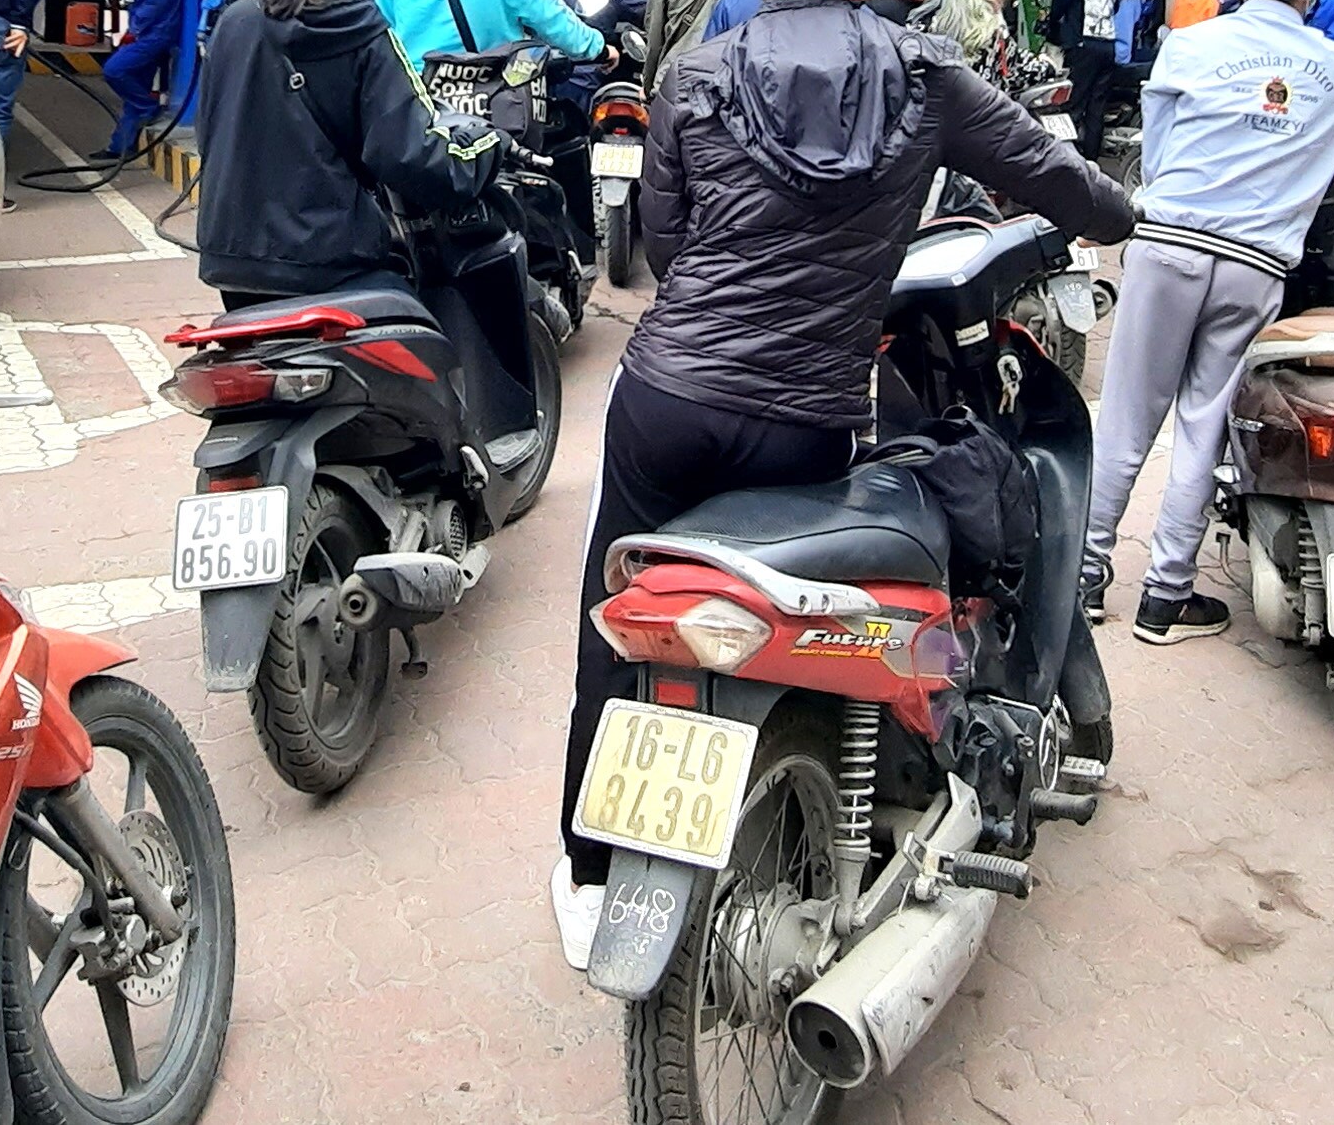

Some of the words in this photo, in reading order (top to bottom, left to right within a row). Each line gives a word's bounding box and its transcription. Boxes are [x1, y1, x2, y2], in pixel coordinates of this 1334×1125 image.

[1216, 51, 1293, 81] Christian
[1304, 58, 1334, 93] Diro
[192, 495, 268, 541] 25-B1
[181, 537, 277, 584] 856.90
[795, 628, 904, 652] Future
[620, 715, 729, 785] 16-L6
[599, 773, 713, 851] 8439
[608, 882, 676, 934] 648
